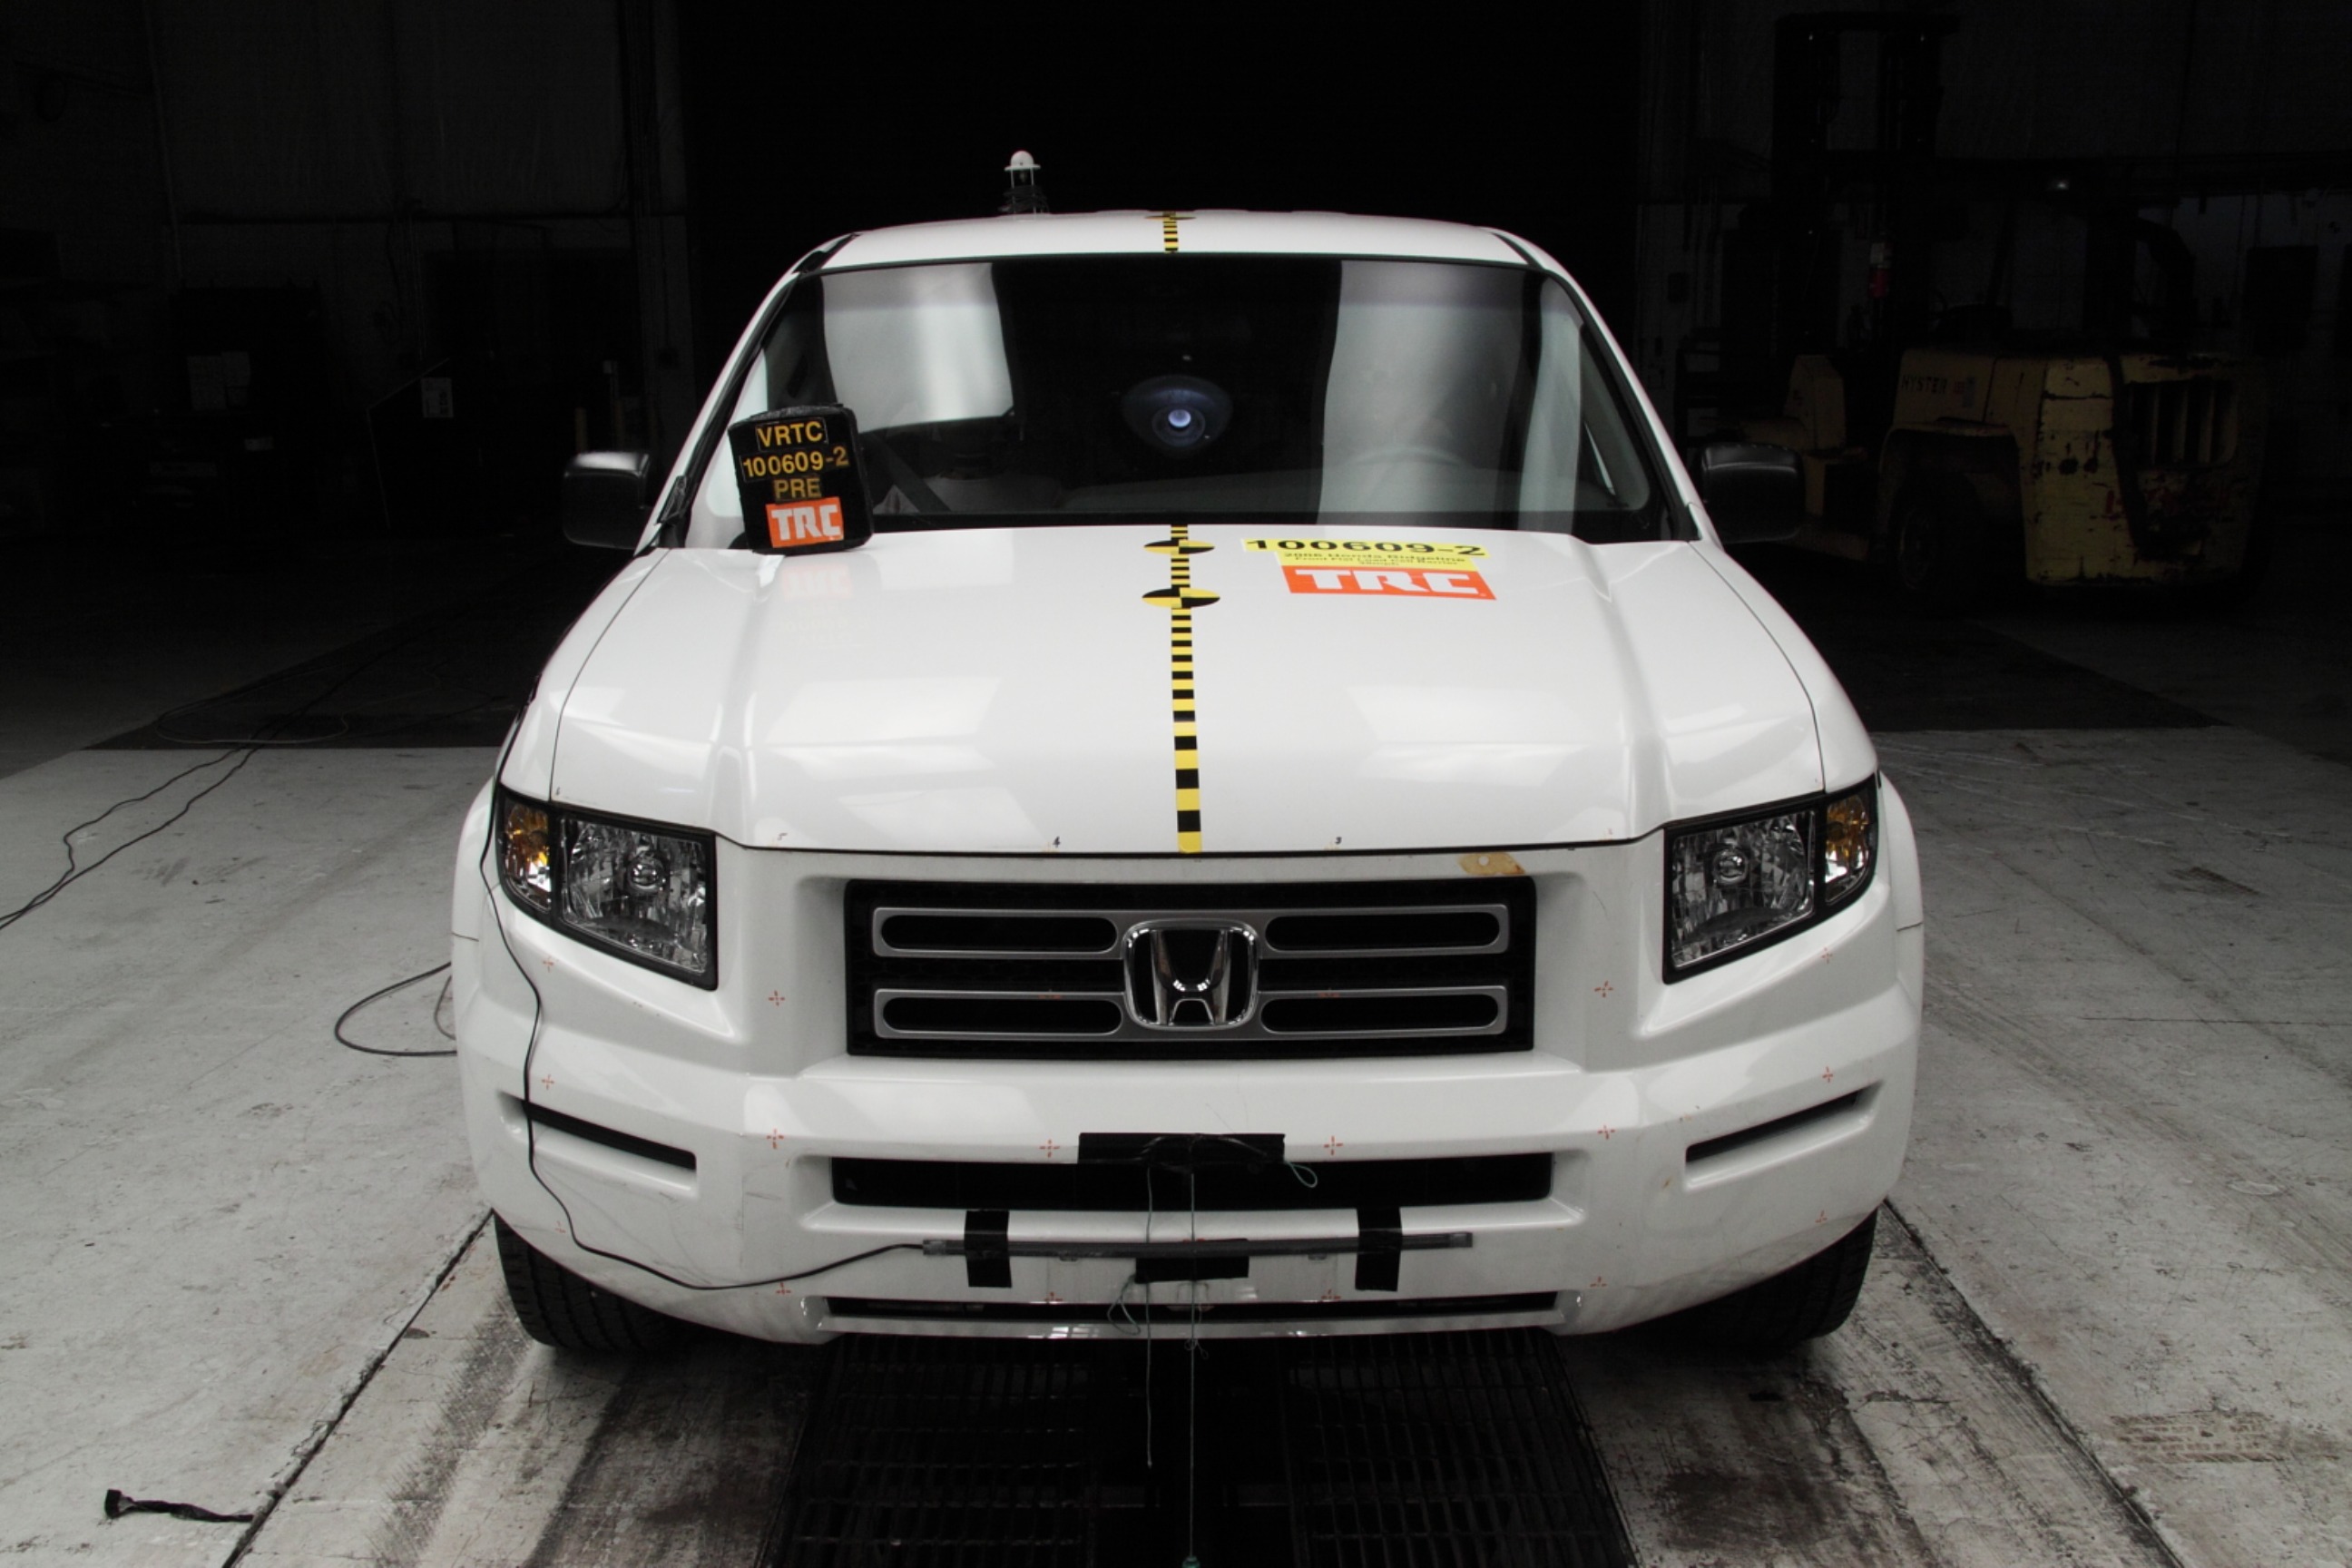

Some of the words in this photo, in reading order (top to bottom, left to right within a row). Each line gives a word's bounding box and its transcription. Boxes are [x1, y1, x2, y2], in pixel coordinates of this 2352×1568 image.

[757, 420, 823, 447] VRTC
[742, 446, 850, 477] 100609-2
[774, 478, 822, 499] PRE
[770, 504, 842, 541] TRC
[1246, 539, 1485, 556] 100609-2
[1294, 569, 1479, 594] TRC
